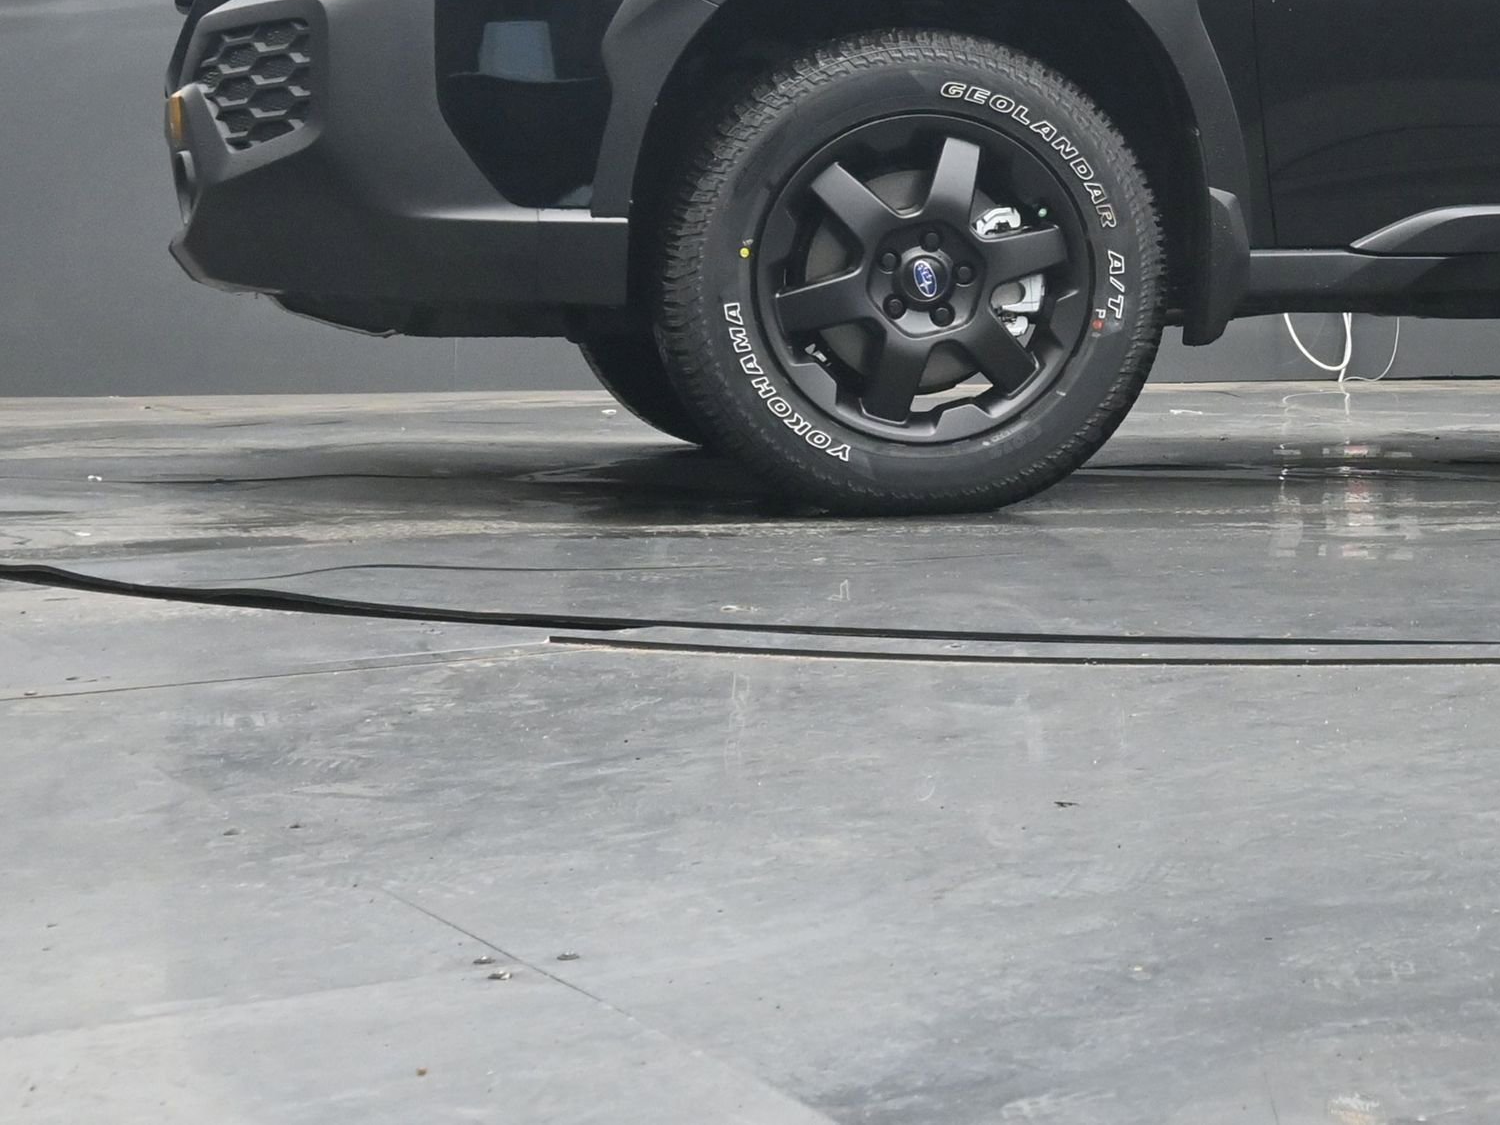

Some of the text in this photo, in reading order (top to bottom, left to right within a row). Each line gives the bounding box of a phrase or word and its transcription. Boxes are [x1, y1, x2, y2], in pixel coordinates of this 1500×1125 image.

[940, 81, 1125, 319] GEOLANDAR A/T
[724, 302, 852, 462] YOKOHAMA
